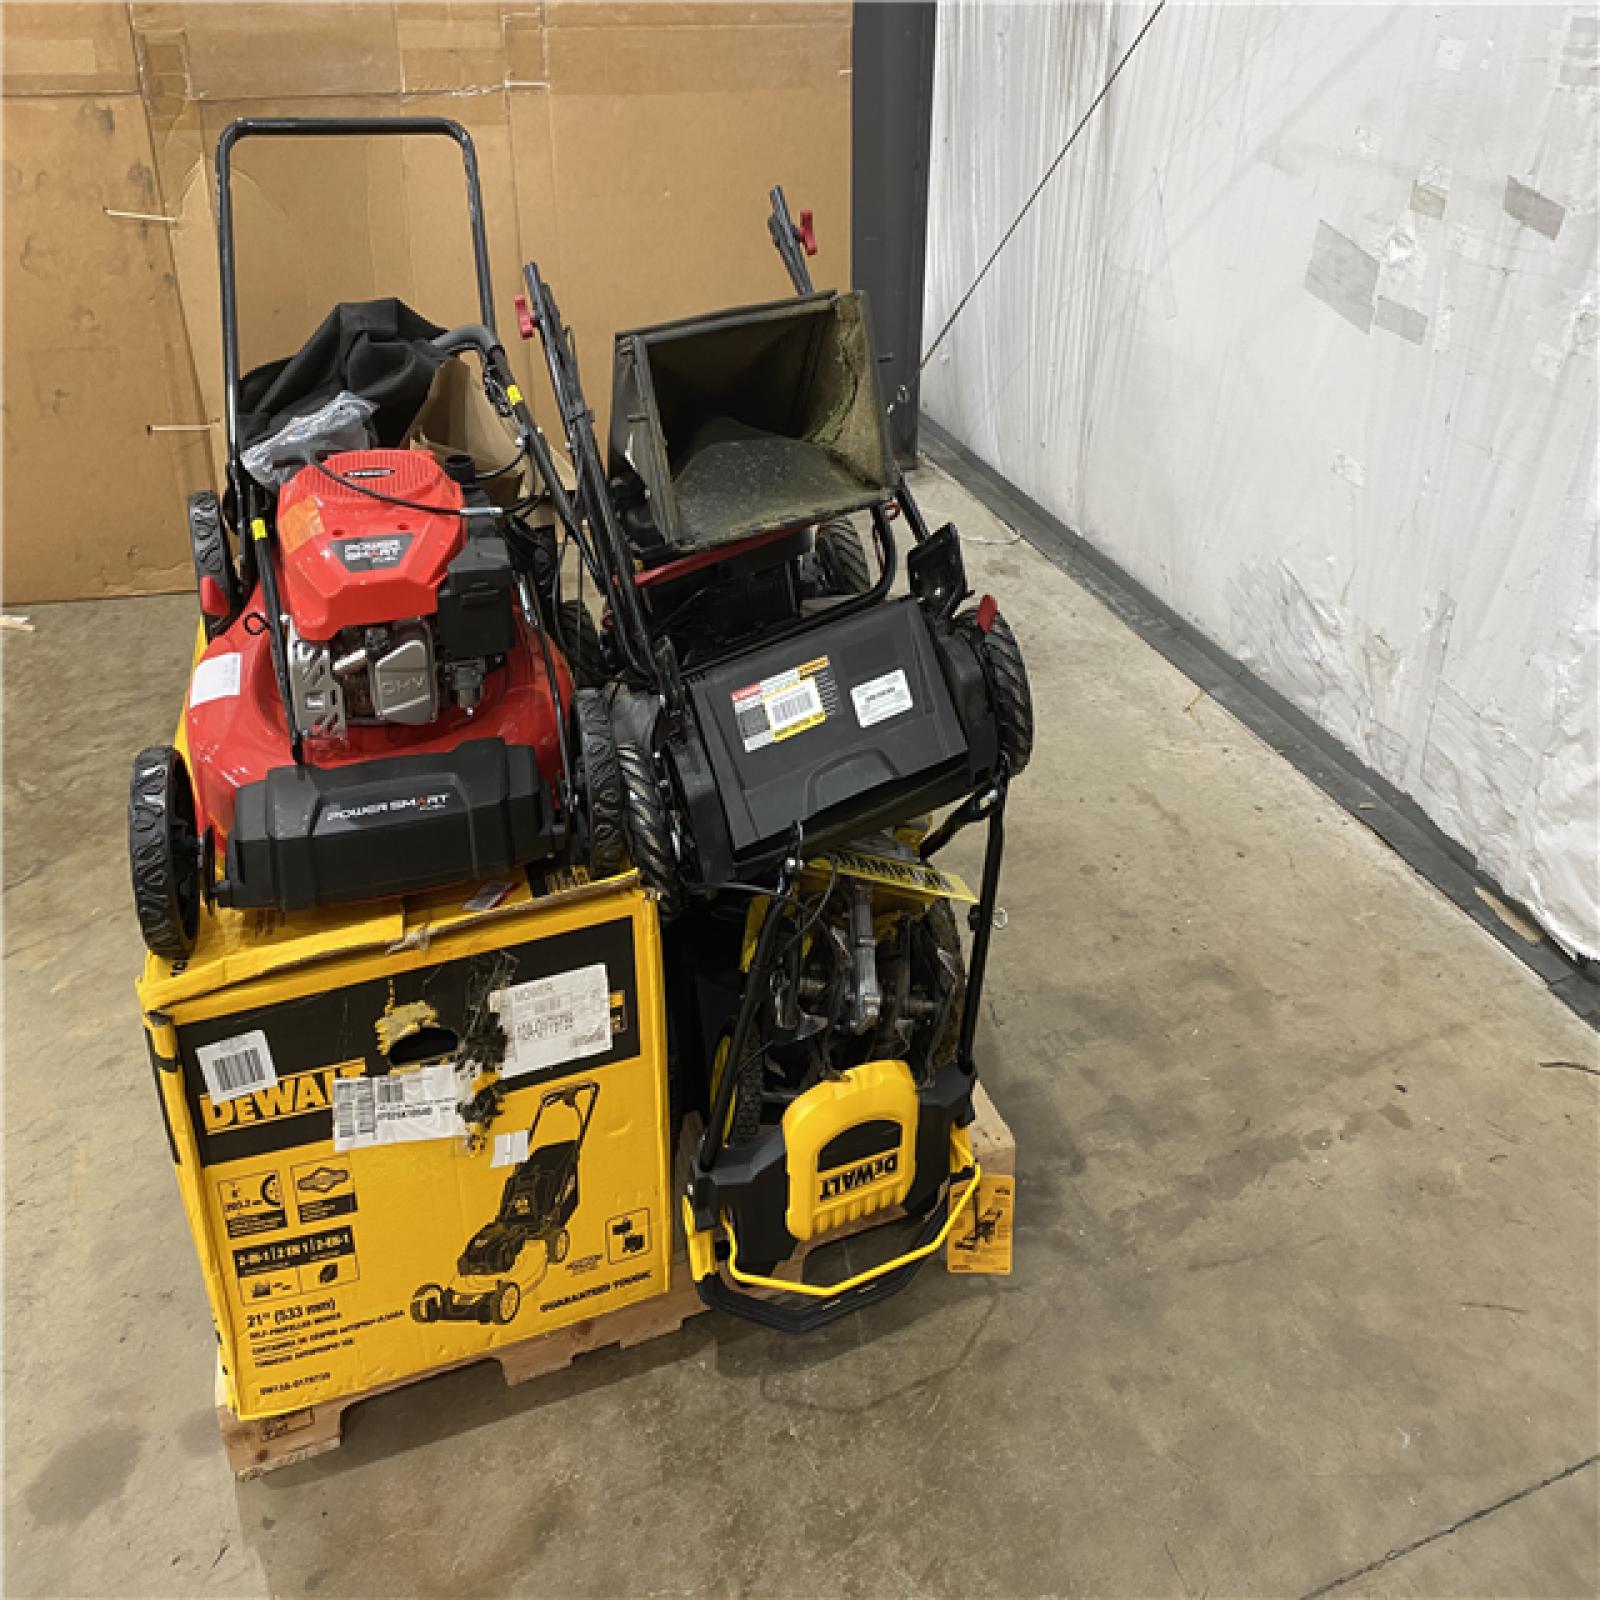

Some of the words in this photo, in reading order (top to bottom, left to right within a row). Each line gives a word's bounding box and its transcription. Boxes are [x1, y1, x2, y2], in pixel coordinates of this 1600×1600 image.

[345, 540, 400, 552] POWER
[345, 548, 401, 561] SMART
[381, 677, 423, 693] OHV
[820, 1154, 899, 1202] DEWALT
